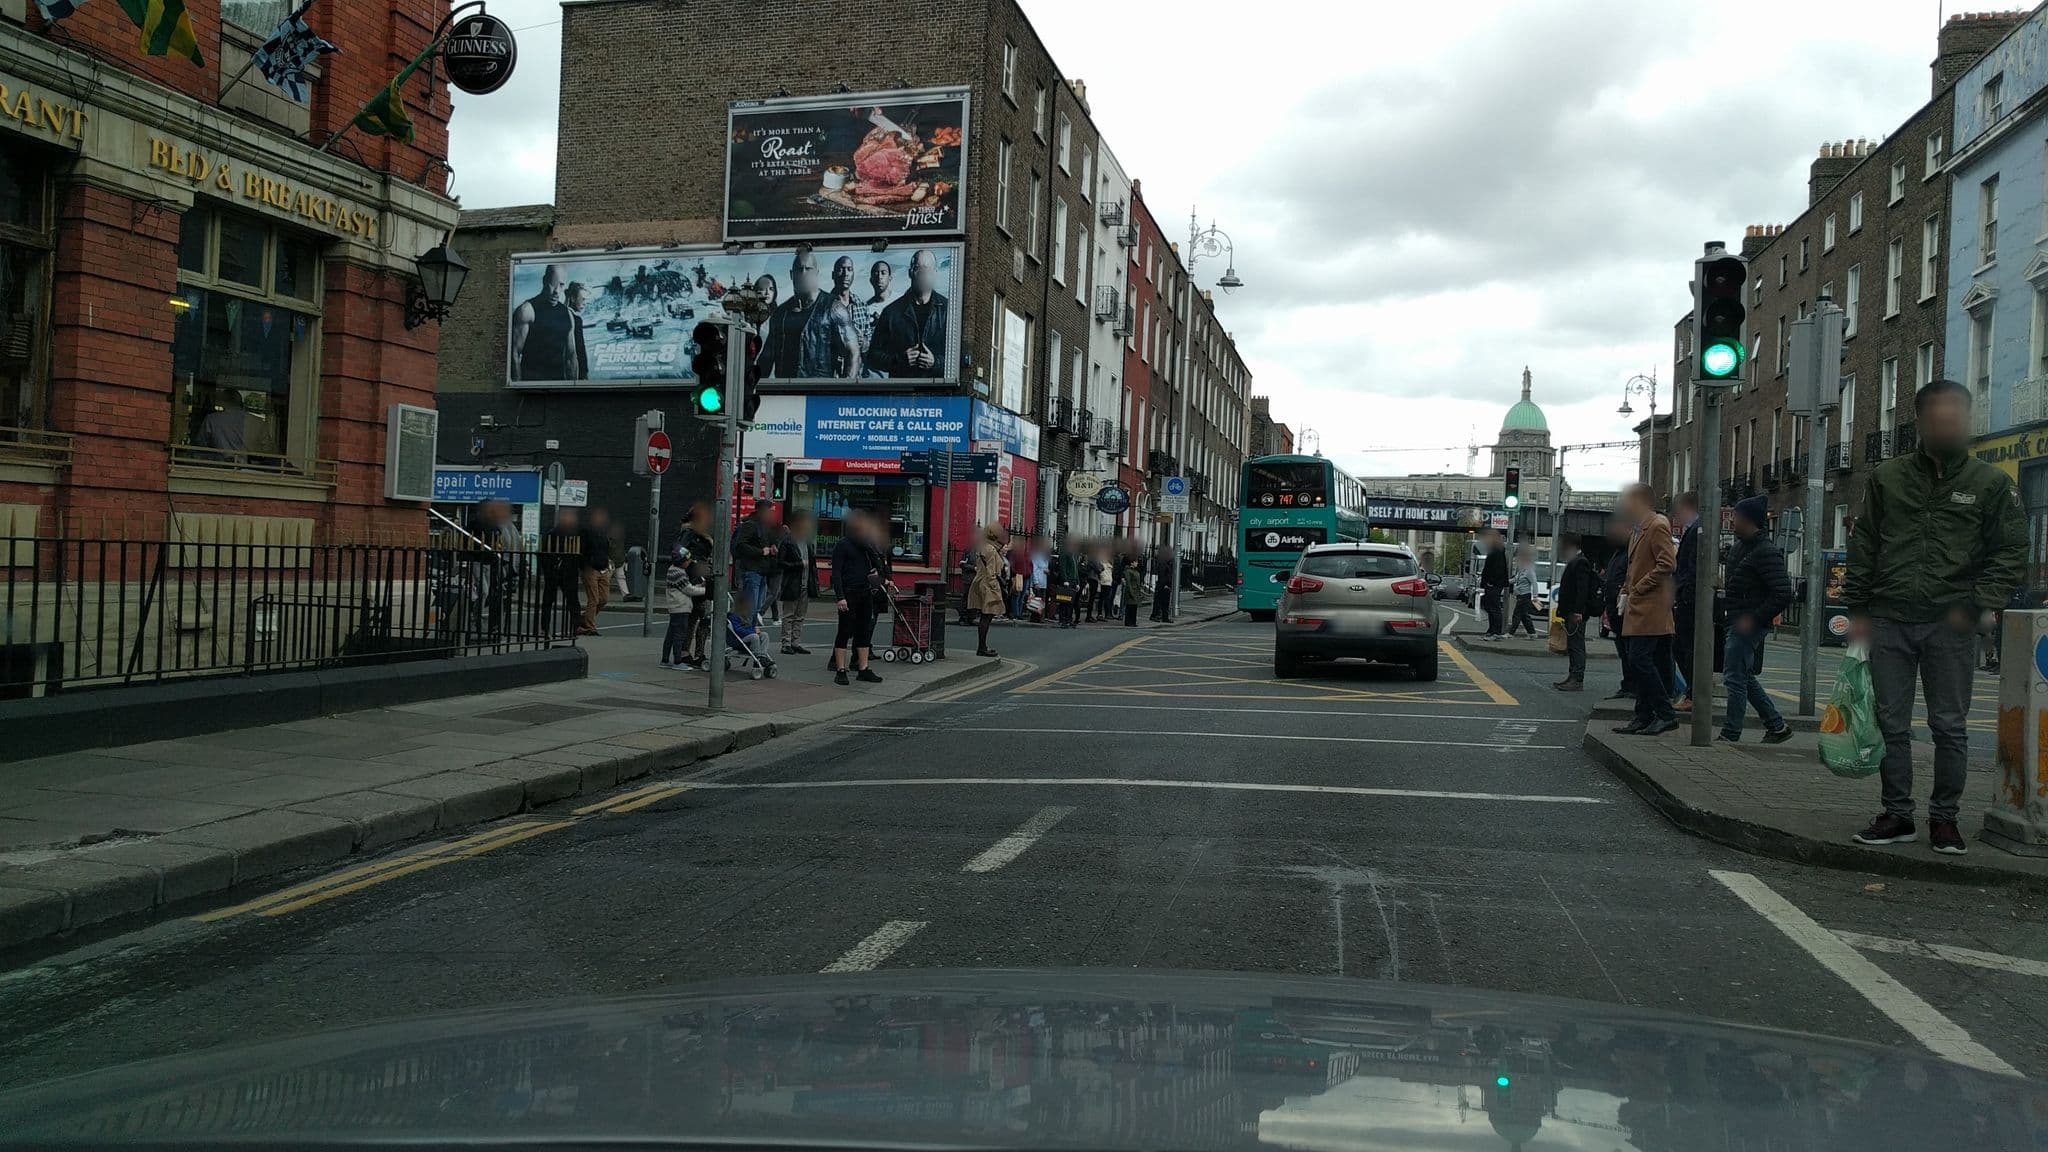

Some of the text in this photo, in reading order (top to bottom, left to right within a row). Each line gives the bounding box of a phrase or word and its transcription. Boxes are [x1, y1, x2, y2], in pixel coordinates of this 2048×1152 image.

[447, 38, 507, 55] GUINNESS
[753, 127, 767, 137] IT'S
[768, 128, 791, 137] MORE
[792, 127, 814, 135] THAN
[761, 136, 813, 160] Roast
[751, 159, 765, 168] IT'S
[766, 160, 790, 168] EXTRA
[771, 168, 786, 176] THE
[216, 162, 235, 192] &
[243, 170, 379, 241] BREAKFAST
[901, 207, 944, 230] finest
[594, 343, 634, 356] FAST
[596, 343, 678, 366] FURIOUS 8
[838, 407, 943, 418] UNLOCKING MASTER
[746, 421, 802, 432] ycamobile
[817, 419, 963, 431] INTERNET CAFÉ & CALL SHOP
[819, 434, 861, 442] PHOTOCOPY
[846, 461, 901, 470] Unlocking Master
[436, 474, 512, 490] epair Centre
[1279, 495, 1294, 505] 747
[1369, 505, 1448, 521] RSELF AT HOME SAM
[1249, 517, 1262, 526] city
[1266, 517, 1290, 526] airport
[1281, 536, 1305, 544] Airlink
